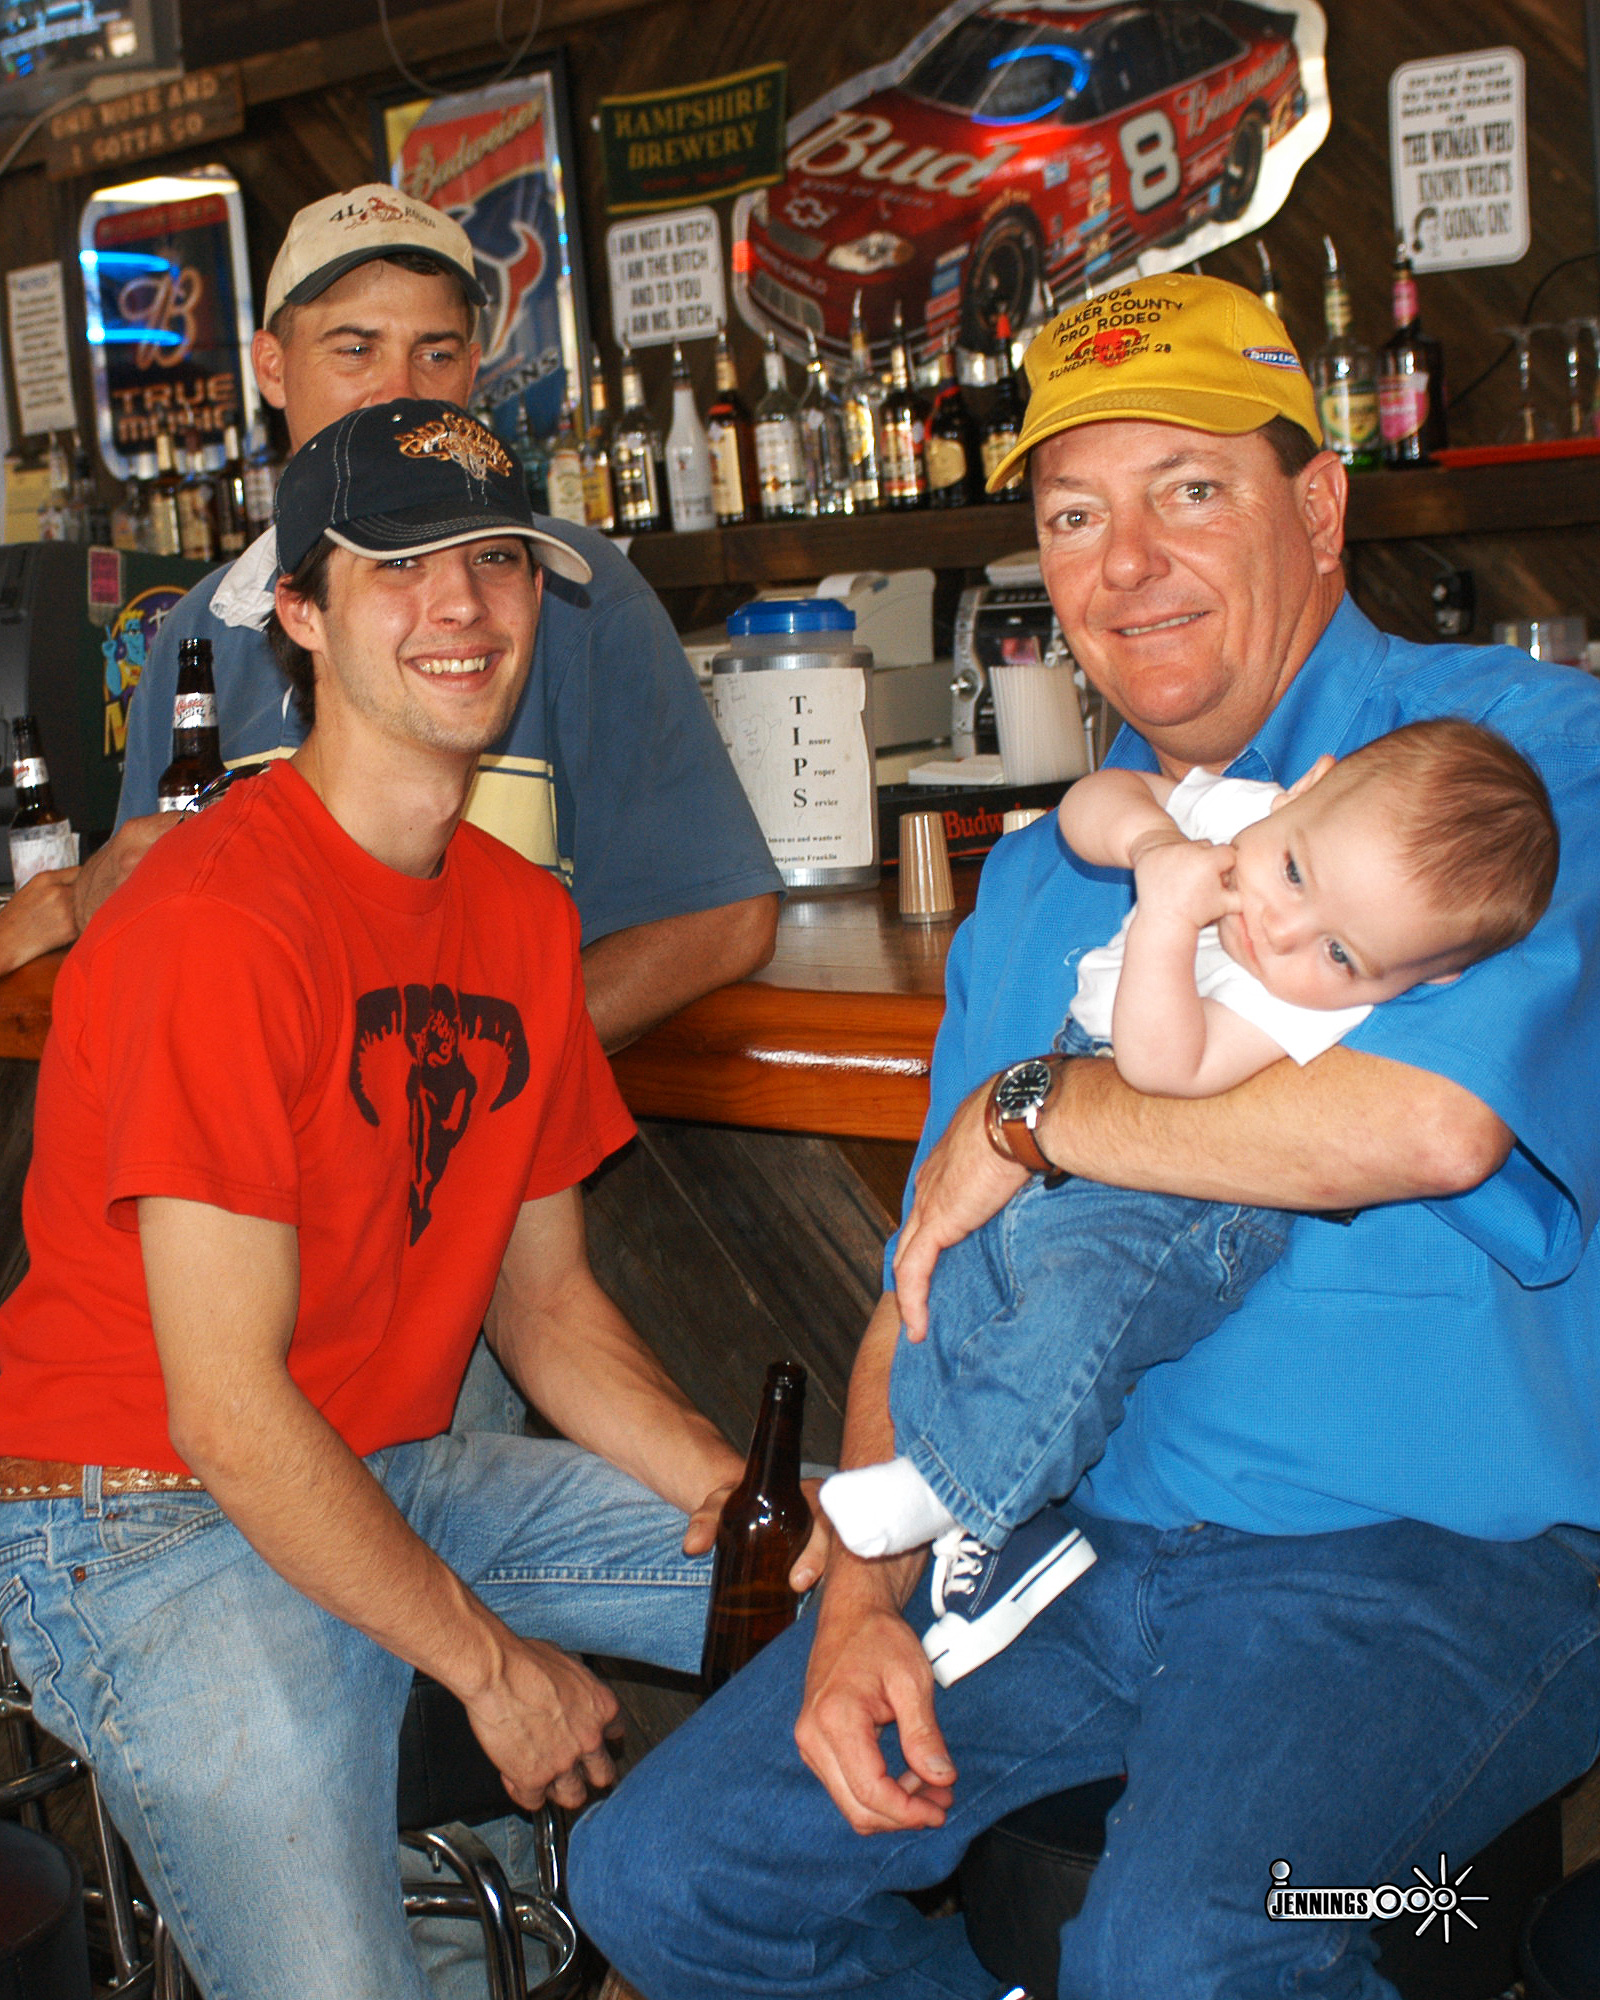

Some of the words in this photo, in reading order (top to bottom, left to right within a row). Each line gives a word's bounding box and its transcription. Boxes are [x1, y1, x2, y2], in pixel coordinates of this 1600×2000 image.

[167, 73, 218, 108] AND
[613, 80, 773, 138] HAMPSHIRE
[92, 121, 164, 162] GOTTA
[628, 119, 758, 171] BREWERY
[786, 110, 1023, 197] Bud
[1402, 132, 1428, 167] THE
[1432, 127, 1480, 161] WOMAN
[1483, 120, 1514, 154] WHO
[1119, 110, 1181, 215] 8
[1417, 168, 1462, 203] KNOWS
[621, 234, 636, 256] AM
[640, 227, 661, 250] NOT
[676, 219, 714, 246] BITCH
[1443, 205, 1483, 241] GOING
[628, 259, 644, 280] AM
[647, 252, 668, 277] THE
[672, 248, 709, 275] BITCH
[631, 285, 654, 307] AND
[657, 281, 672, 303] TO
[676, 278, 702, 301] YOU
[1085, 287, 1133, 309] 2004
[1110, 297, 1183, 313] COUNTY
[632, 313, 648, 333] AM
[677, 303, 713, 329] BITCH
[1059, 324, 1090, 347] PRO
[1098, 311, 1162, 332] RODEO
[1048, 356, 1096, 382] SUNDAY
[1103, 343, 1150, 361] MARCH
[1154, 342, 1172, 354] 28
[1064, 343, 1111, 363] MARCH
[1250, 350, 1278, 361] BUD
[112, 372, 238, 414] TRUE
[807, 853, 837, 861] Franklin
